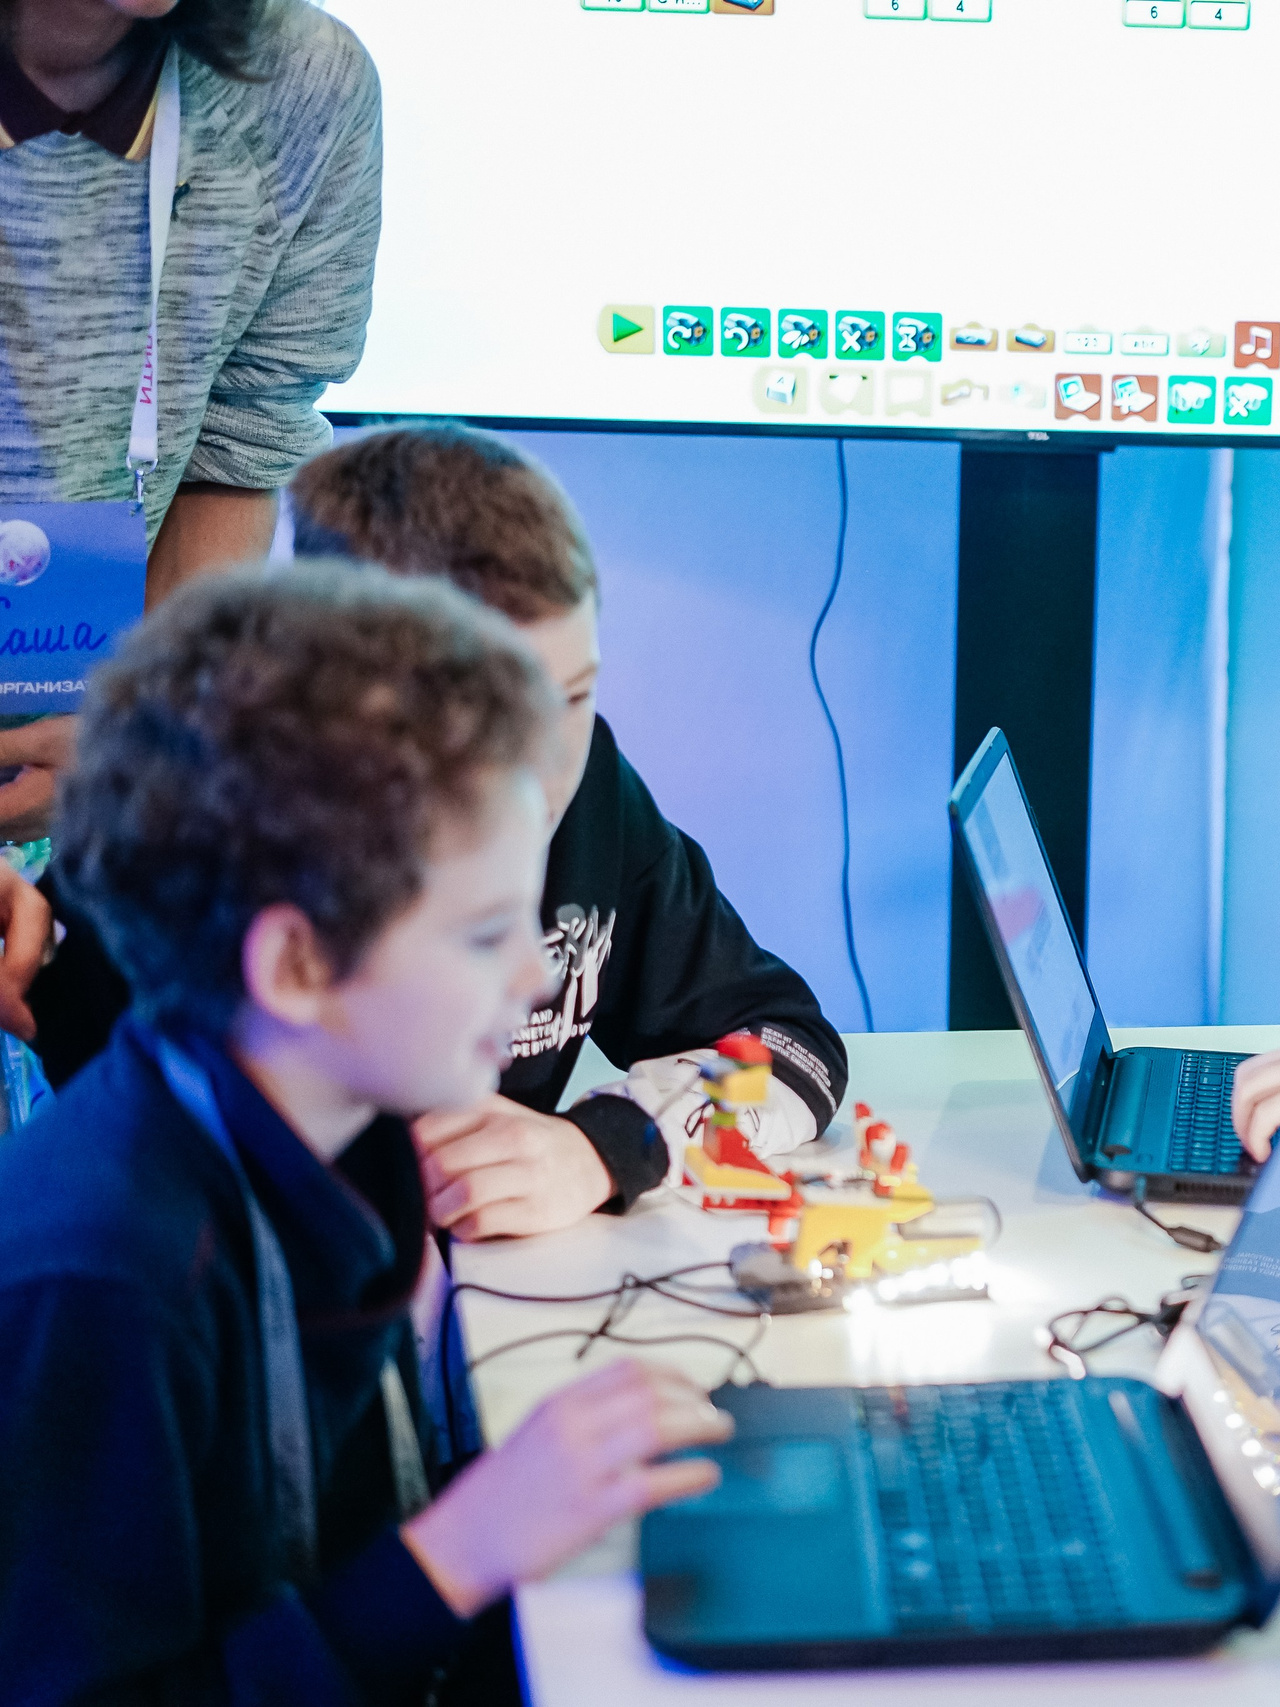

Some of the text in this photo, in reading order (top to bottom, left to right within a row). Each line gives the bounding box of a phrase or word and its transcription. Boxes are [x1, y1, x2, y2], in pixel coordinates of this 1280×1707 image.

[1150, 6, 1222, 21] 6 4
[0, 680, 88, 695] РГАНИЗА
